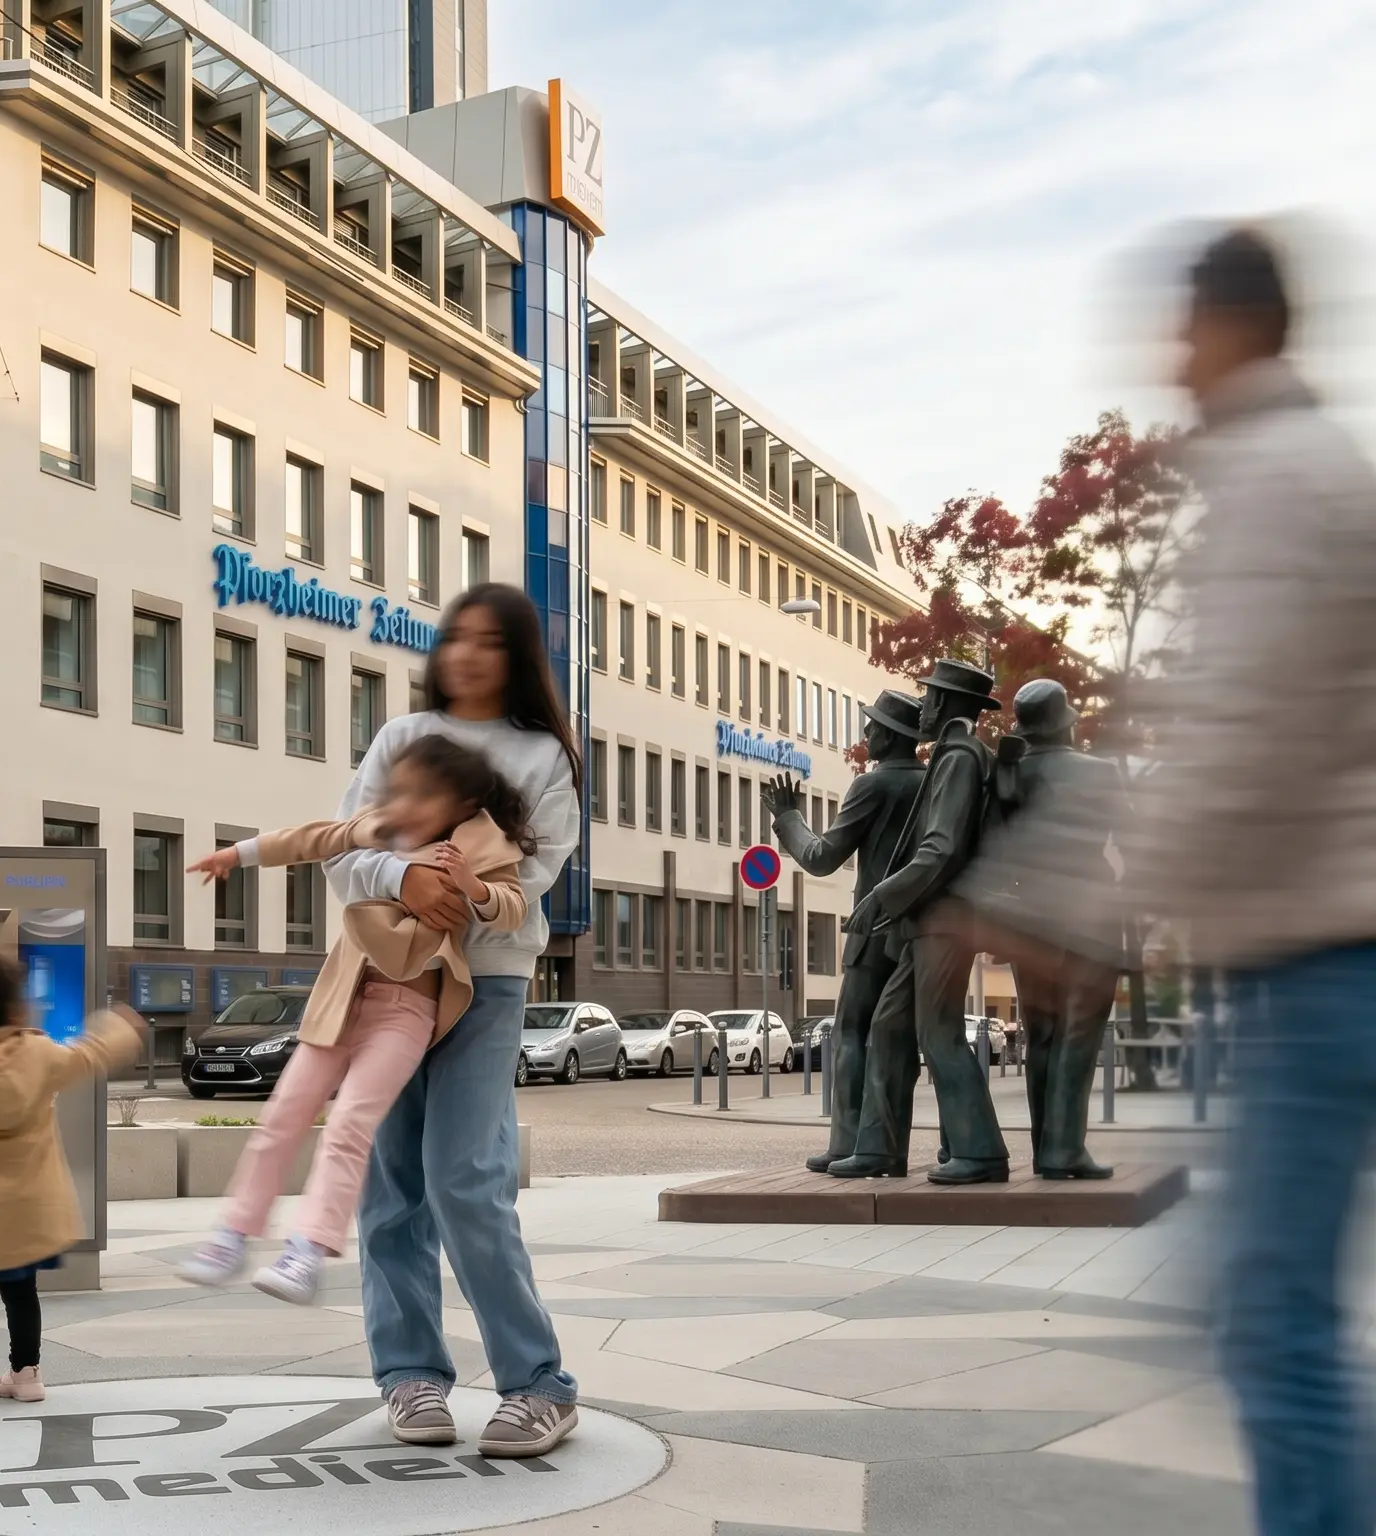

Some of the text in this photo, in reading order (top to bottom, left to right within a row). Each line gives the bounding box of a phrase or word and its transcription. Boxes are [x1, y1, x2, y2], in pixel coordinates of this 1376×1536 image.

[567, 100, 602, 187] PZ
[212, 543, 440, 656] Pforzheimer Zeitun
[0, 1396, 466, 1474] PZ
